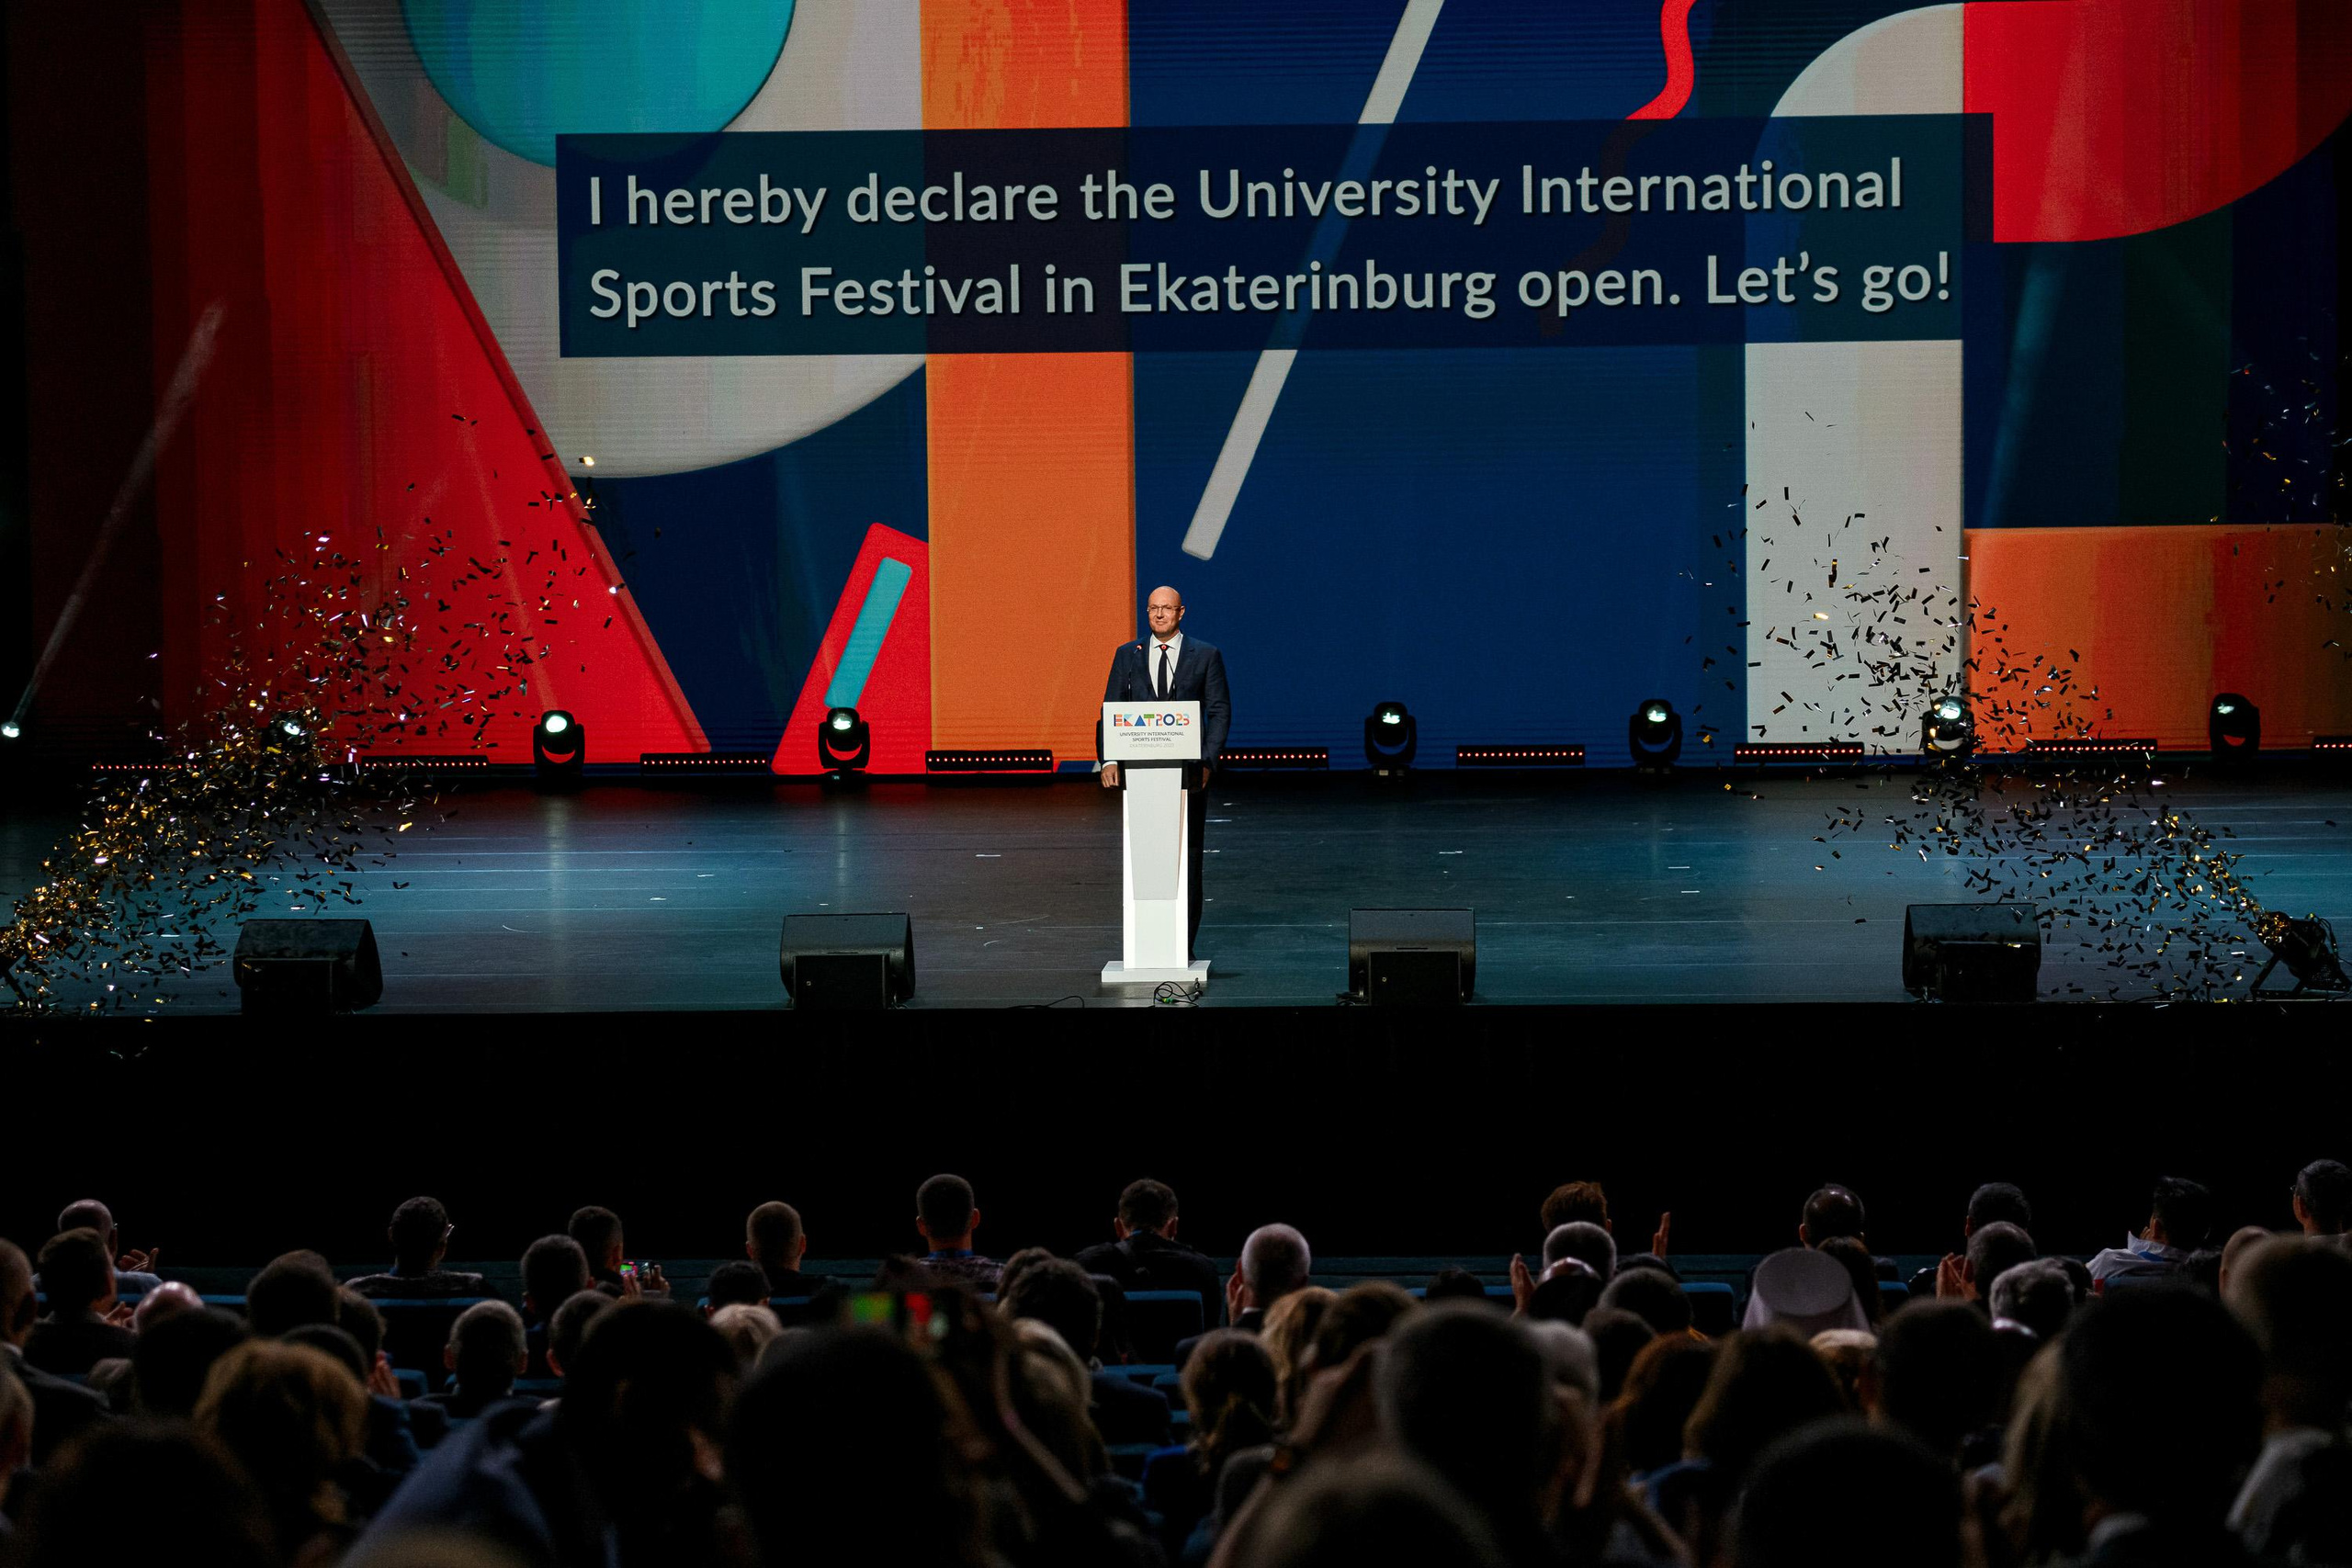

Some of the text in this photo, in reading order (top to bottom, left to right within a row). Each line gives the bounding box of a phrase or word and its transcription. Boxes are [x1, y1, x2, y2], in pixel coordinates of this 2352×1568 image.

[590, 157, 1901, 234] I hereby declare the University International
[590, 269, 775, 328] Sports
[801, 264, 1020, 315] Festival
[1046, 264, 1093, 312] in
[1121, 259, 1496, 319] Ekaterinburg
[1519, 269, 1680, 318] open.
[1861, 252, 1949, 312] go!
